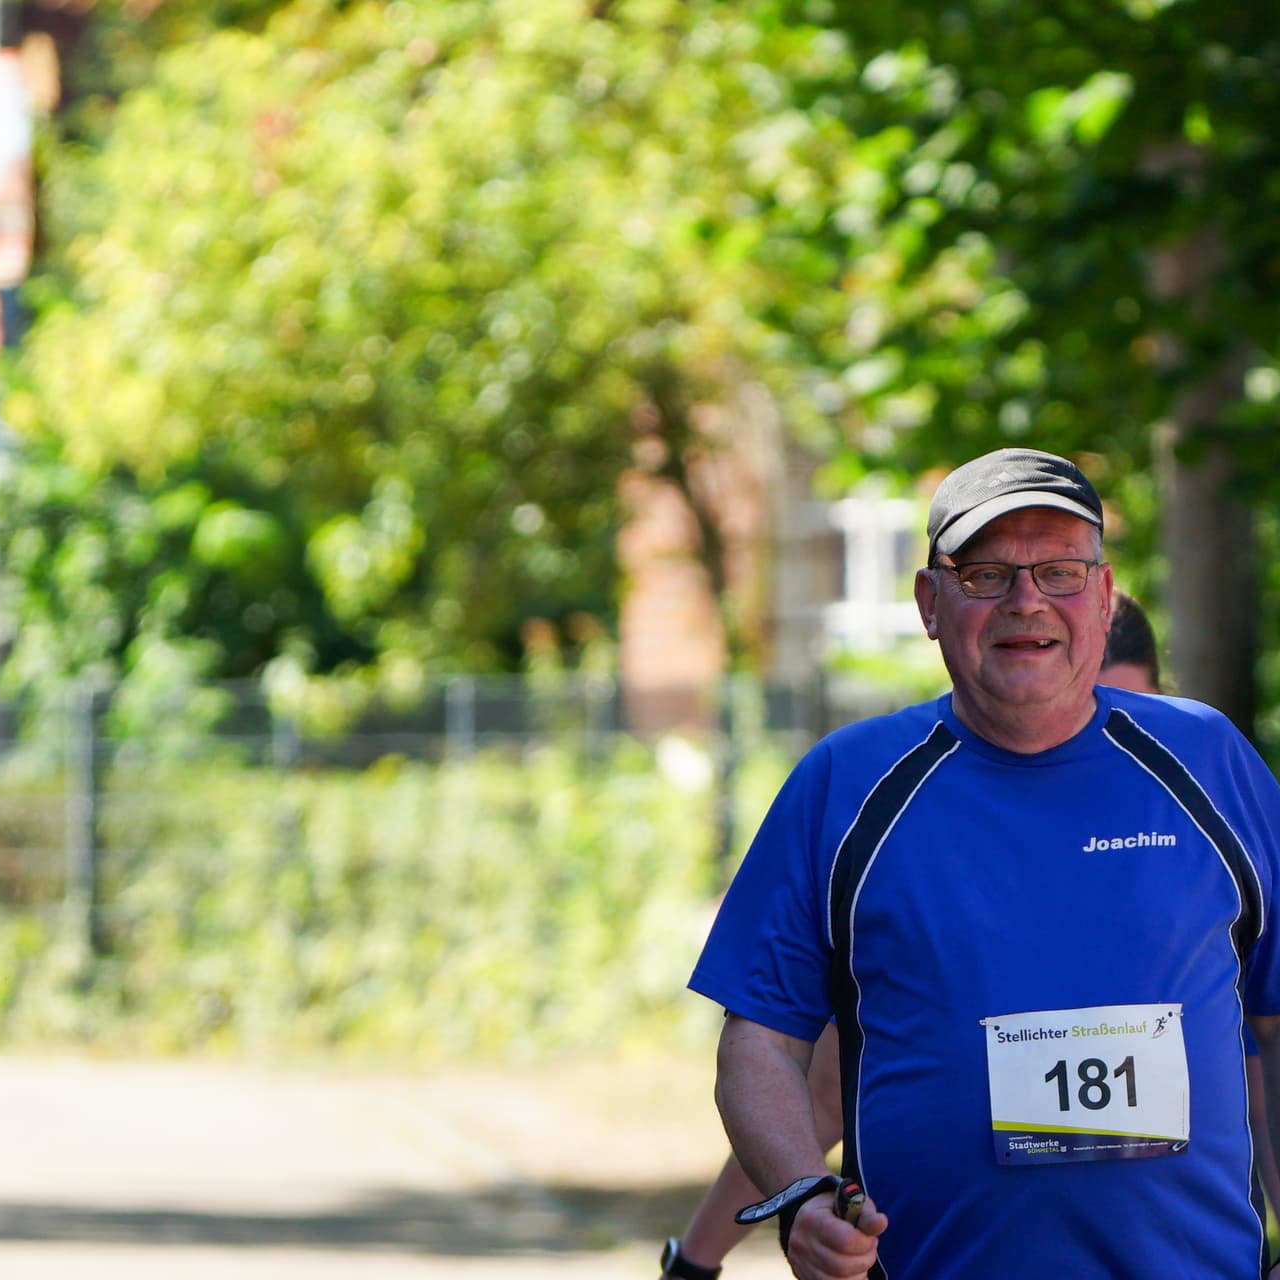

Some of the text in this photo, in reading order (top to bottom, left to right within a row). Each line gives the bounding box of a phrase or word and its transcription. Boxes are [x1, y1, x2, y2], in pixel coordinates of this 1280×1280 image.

[1082, 831, 1177, 853] Joachim
[997, 1021, 1147, 1044] Stellichter Straßenlauf
[1044, 1055, 1137, 1112] 181
[1008, 1139, 1060, 1150] Stadtwerke
